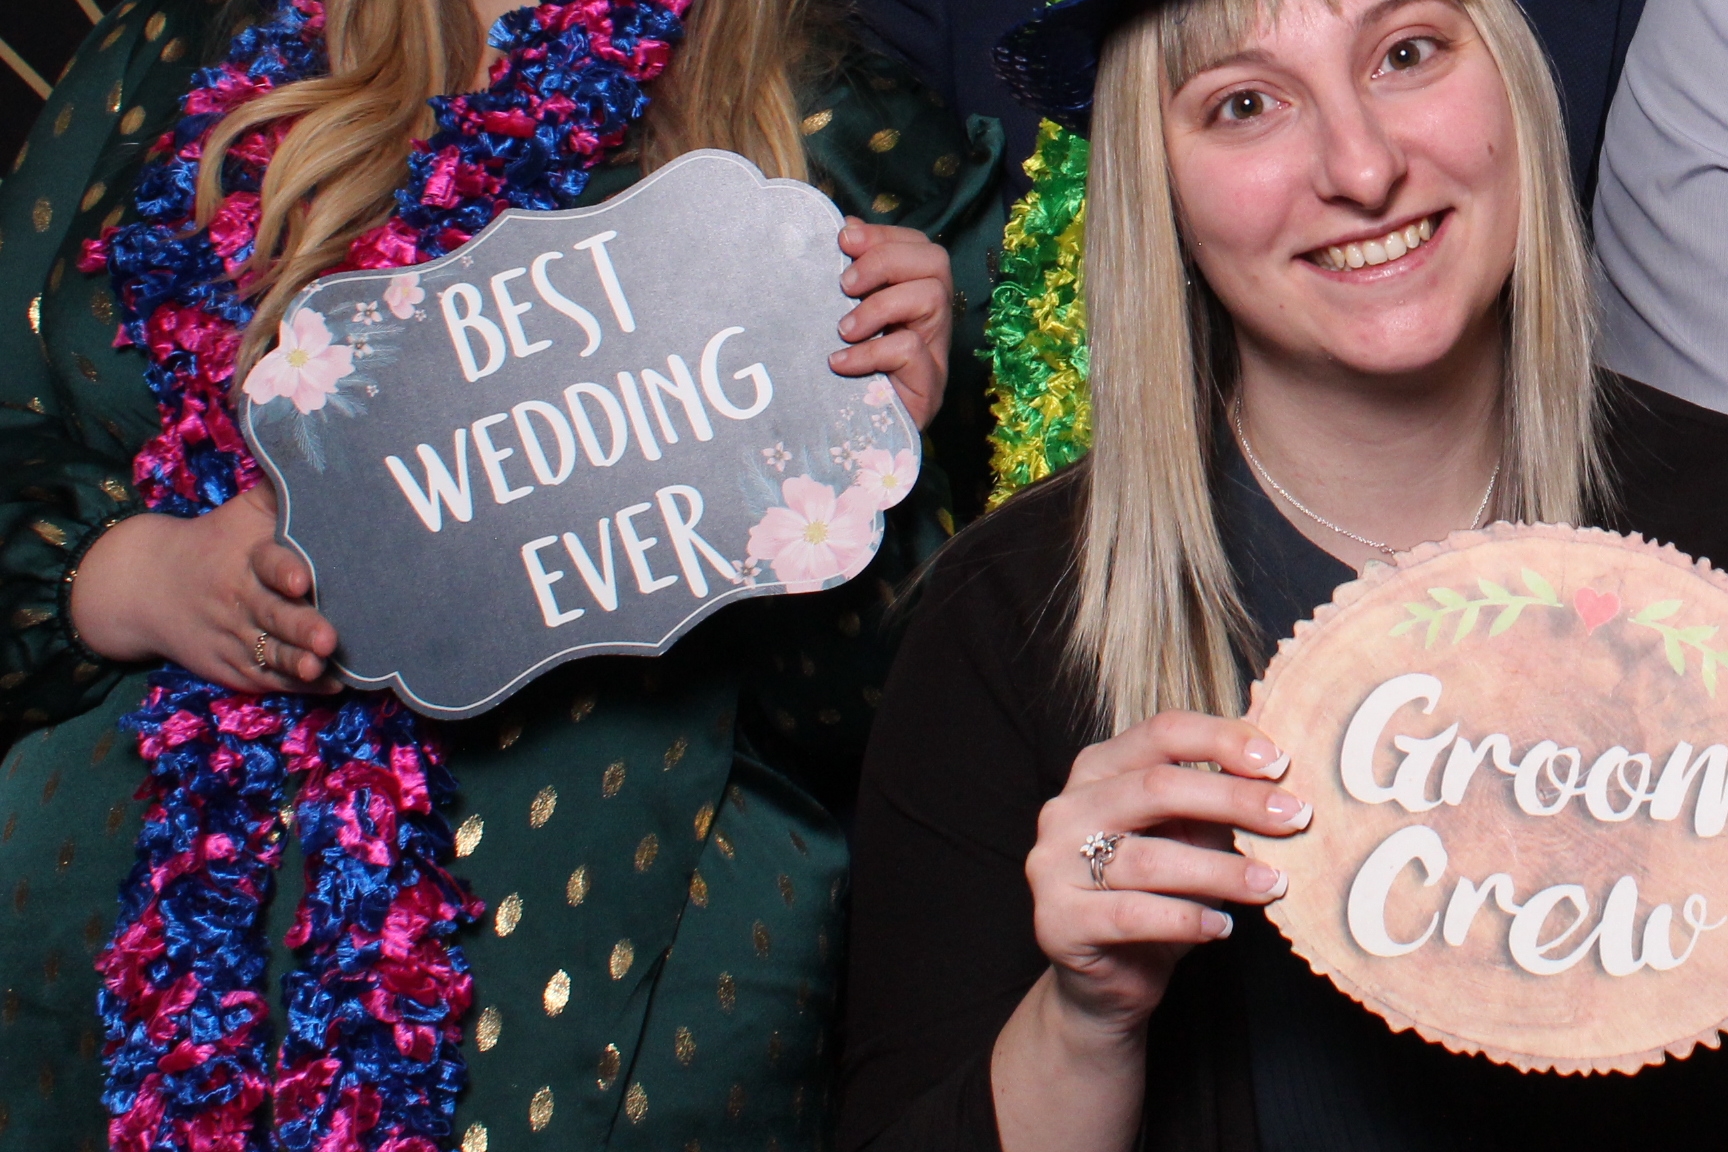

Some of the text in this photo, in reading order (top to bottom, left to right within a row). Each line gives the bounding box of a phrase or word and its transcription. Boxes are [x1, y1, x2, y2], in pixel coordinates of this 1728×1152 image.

[440, 231, 636, 382] BEST
[385, 326, 774, 532] WEDDING
[521, 484, 739, 627] EVER
[1348, 825, 1727, 976] Crew
